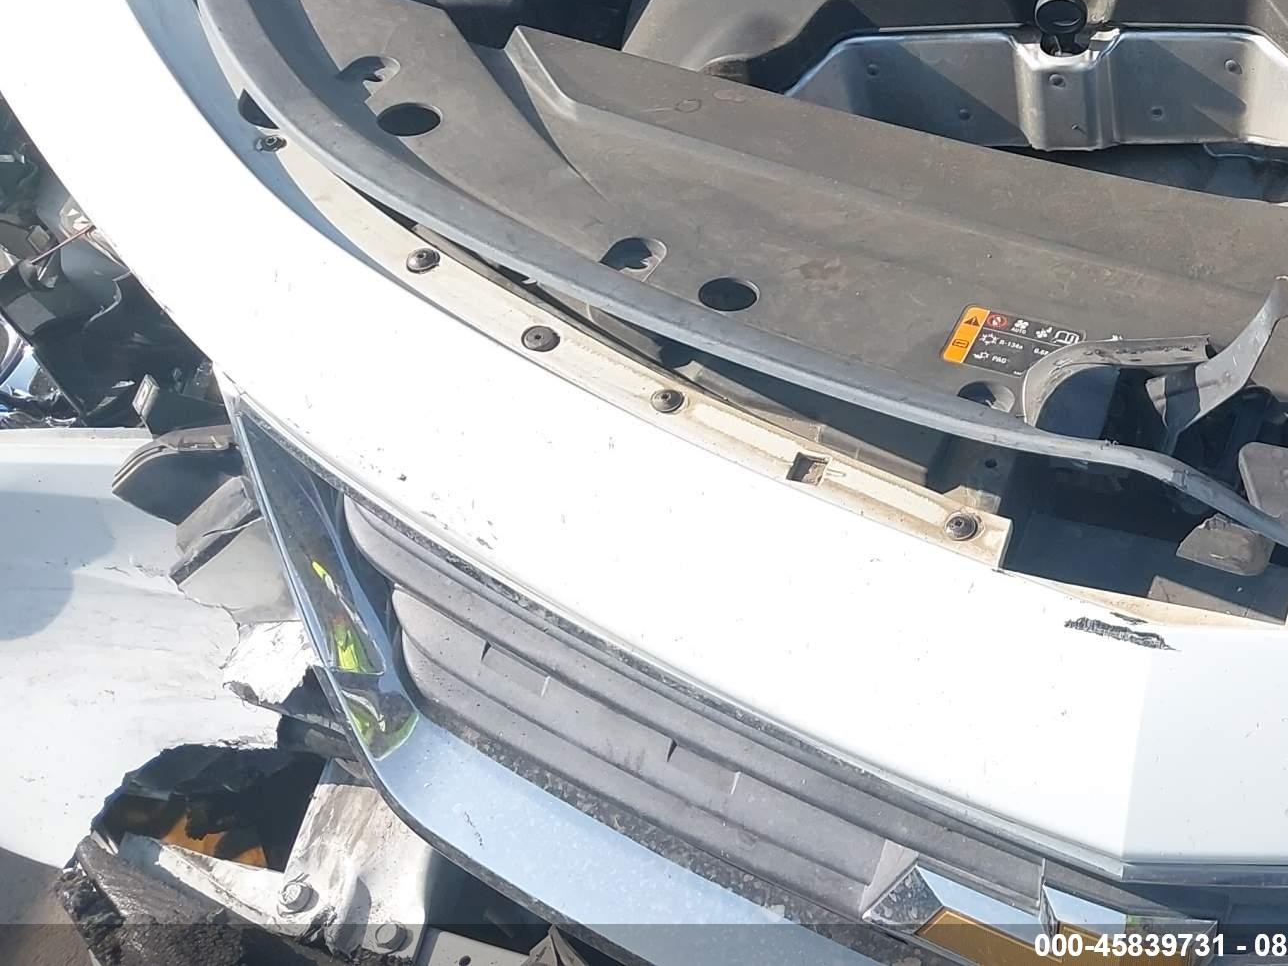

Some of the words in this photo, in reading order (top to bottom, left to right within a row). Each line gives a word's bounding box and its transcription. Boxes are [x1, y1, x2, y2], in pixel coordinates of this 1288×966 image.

[1011, 327, 1027, 335] AUTO
[998, 339, 1024, 350] R-134a
[991, 354, 1008, 364] PAG
